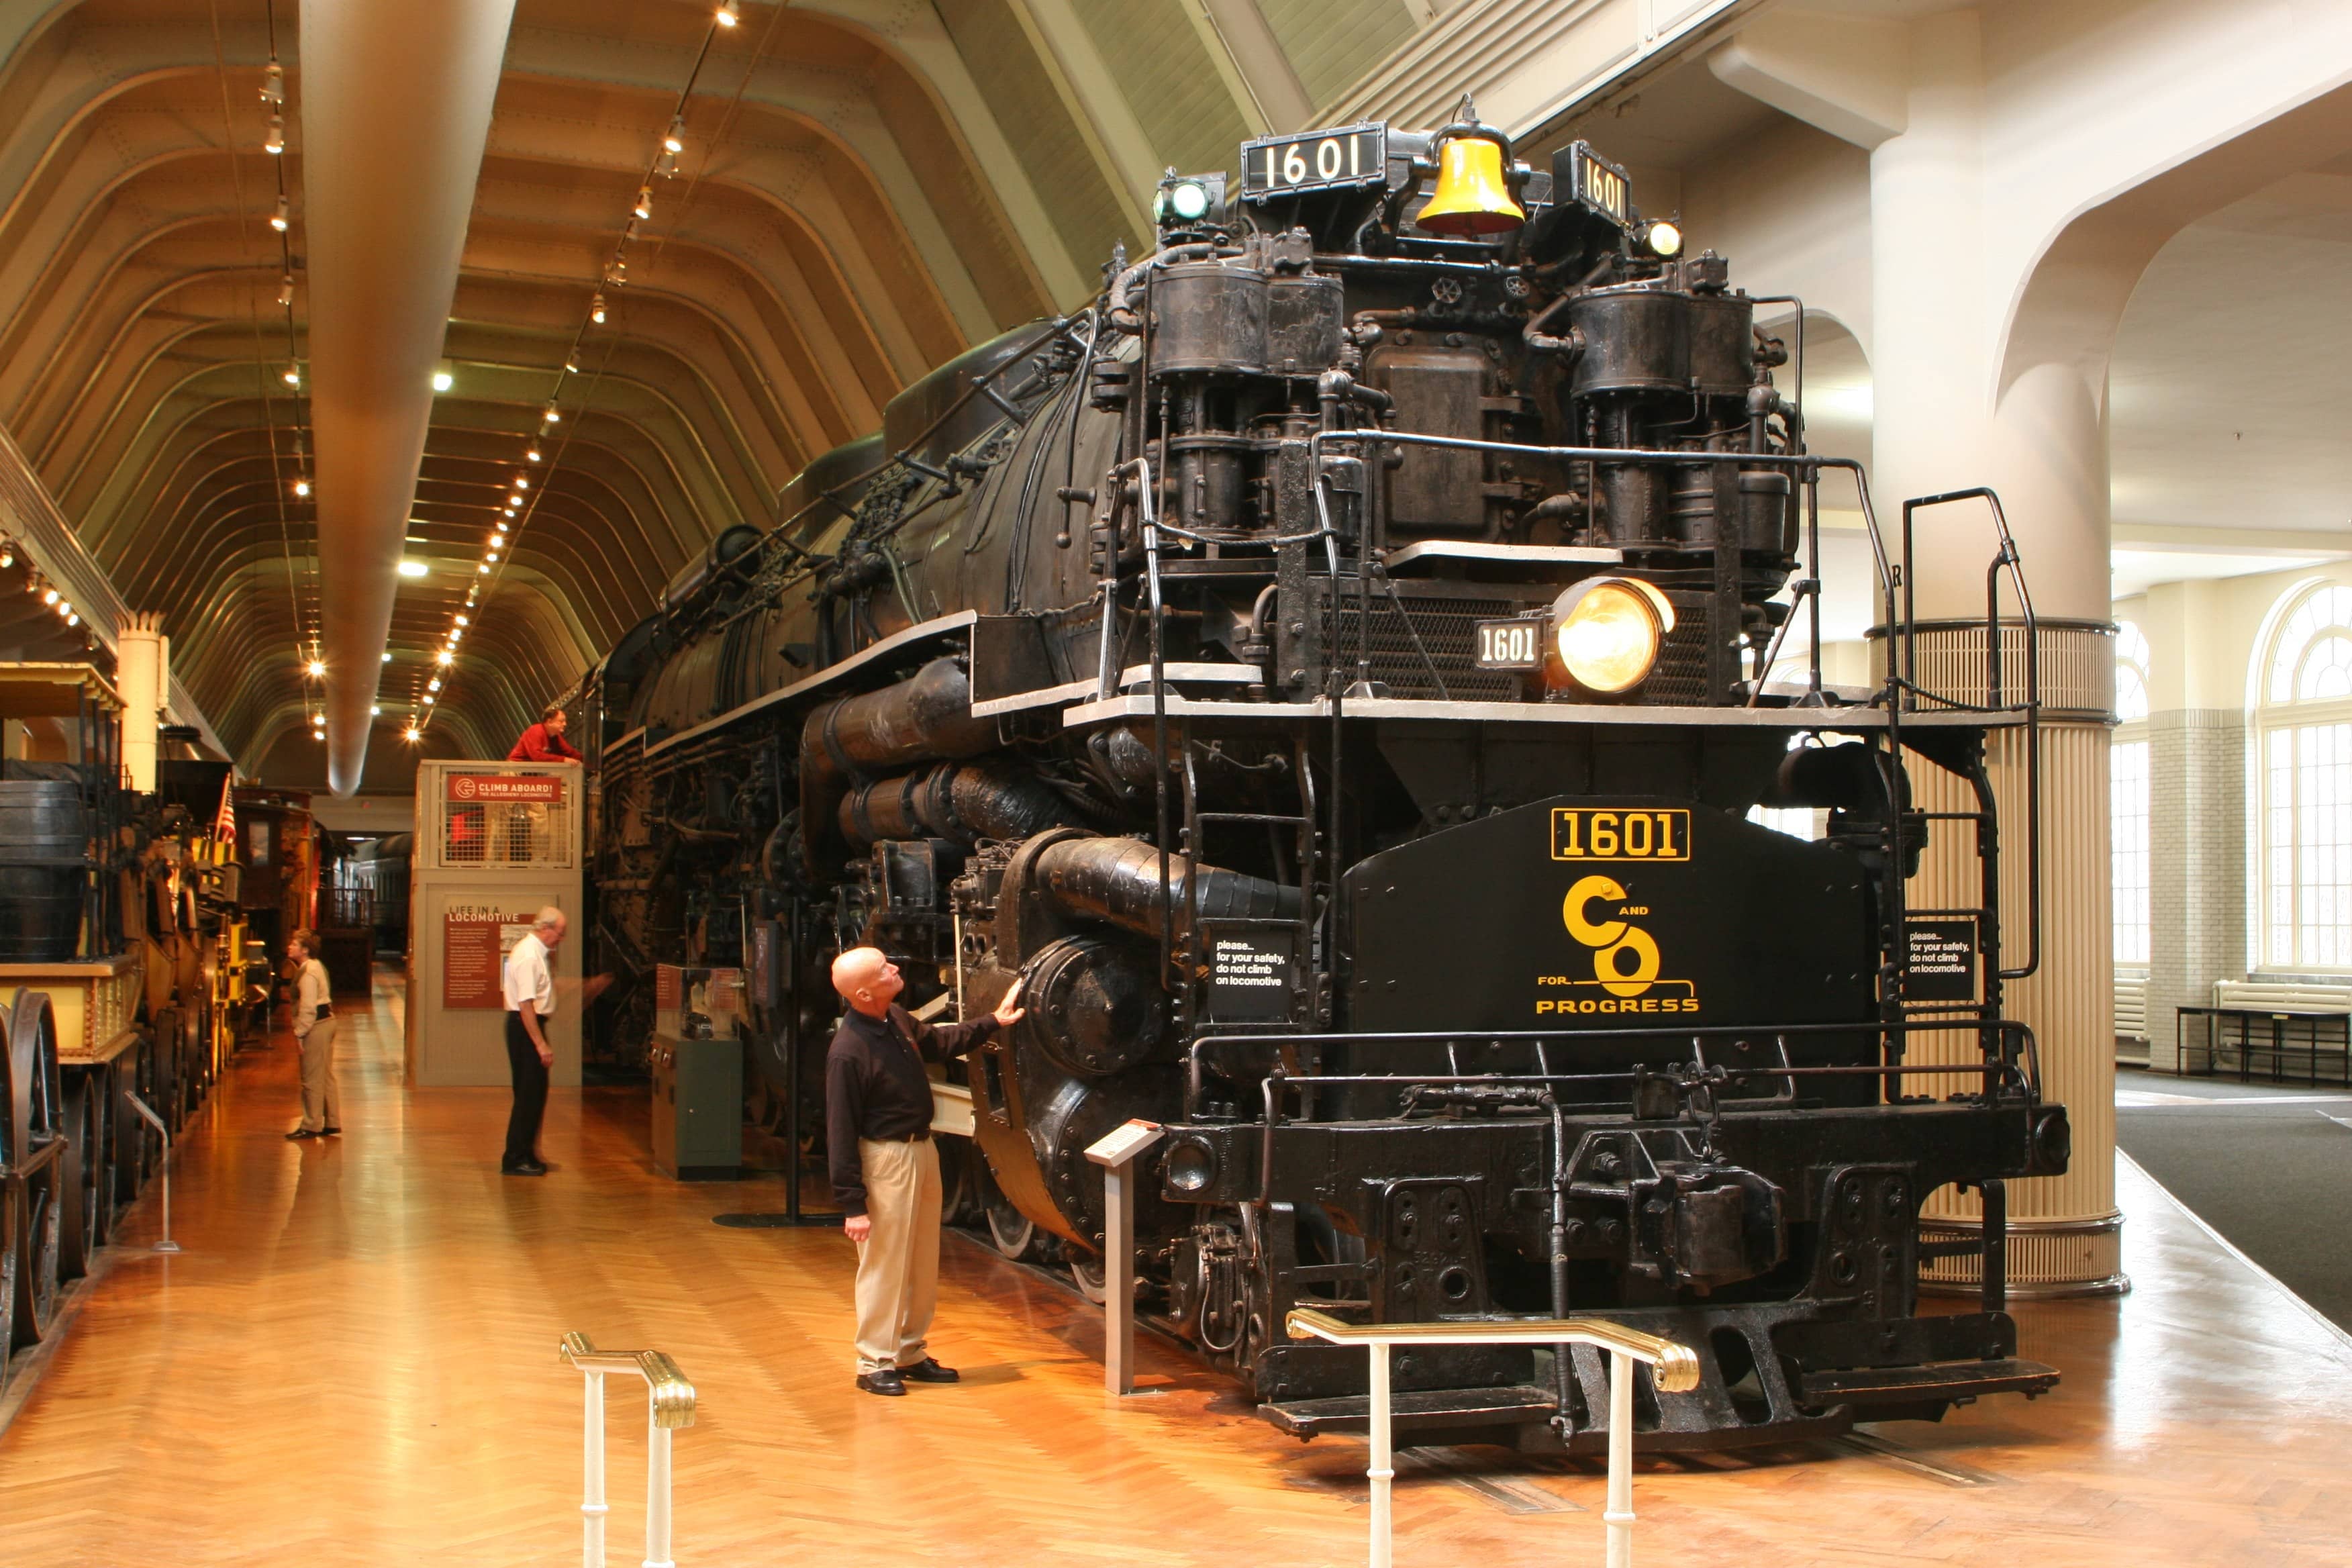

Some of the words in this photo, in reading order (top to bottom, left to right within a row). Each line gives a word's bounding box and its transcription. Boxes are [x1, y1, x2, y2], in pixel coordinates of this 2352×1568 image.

[1265, 134, 1359, 188] 1601
[1586, 158, 1622, 217] 1601
[1482, 628, 1534, 661] 1601
[479, 783, 508, 792] CLIMB
[511, 784, 553, 793] ABOARD!
[1563, 813, 1677, 856] 1601
[1563, 875, 1628, 947] C
[1618, 907, 1649, 915] AND
[449, 913, 520, 922] LOCOMOTIVE
[1910, 942, 1922, 951] for
[1923, 943, 1941, 952] your
[1943, 942, 1969, 952] safety,
[1216, 952, 1230, 961] for
[1232, 954, 1253, 963] your
[1254, 953, 1285, 965] safety,
[1909, 953, 1920, 962] do
[1922, 954, 1936, 962] not
[1937, 953, 1959, 962] climb
[1216, 964, 1229, 973] do
[1230, 965, 1246, 973] not
[1247, 965, 1272, 974] climb
[1921, 964, 1966, 973] locomotive
[1216, 977, 1228, 985] on
[1230, 976, 1282, 986] locomotive
[1537, 977, 1572, 985] FOR
[1536, 999, 1699, 1014] PROGRESS
